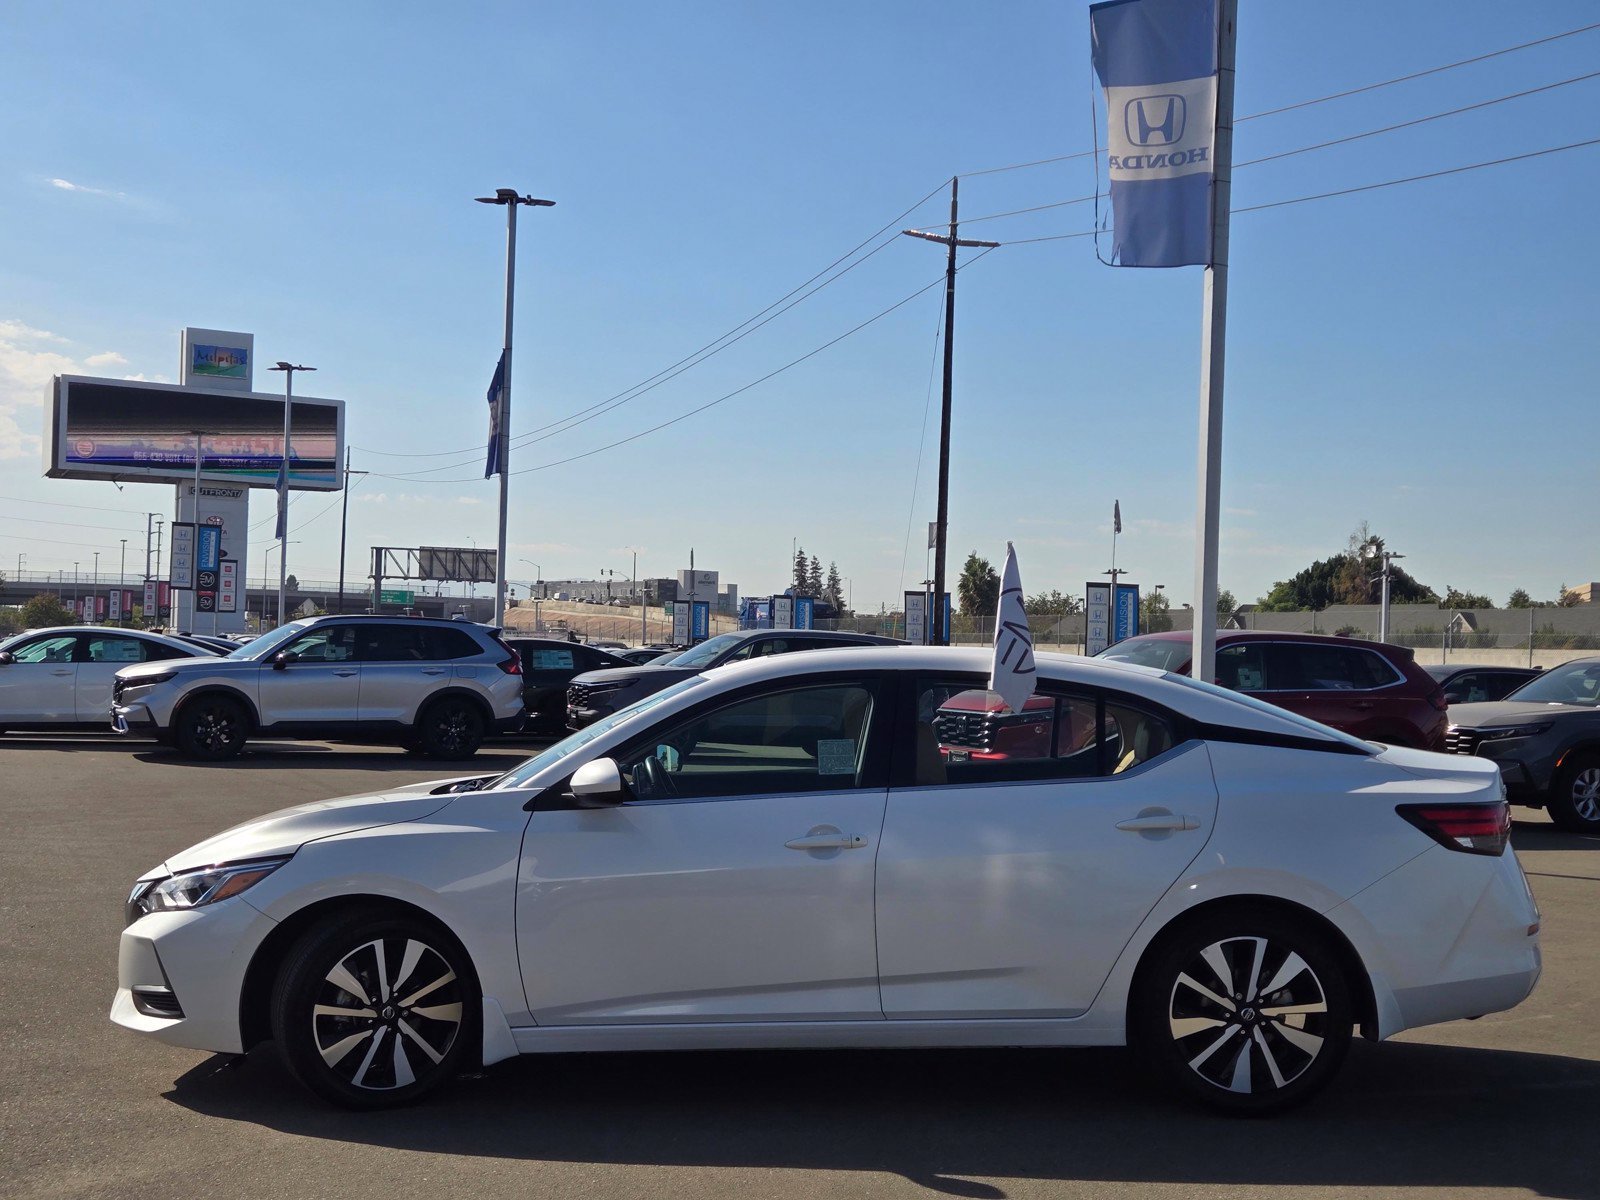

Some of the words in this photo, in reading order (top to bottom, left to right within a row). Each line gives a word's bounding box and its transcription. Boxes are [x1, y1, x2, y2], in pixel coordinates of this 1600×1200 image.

[196, 346, 247, 367] Milpitas
[201, 530, 211, 568] ENVISION
[1119, 592, 1128, 638] ENVISION
